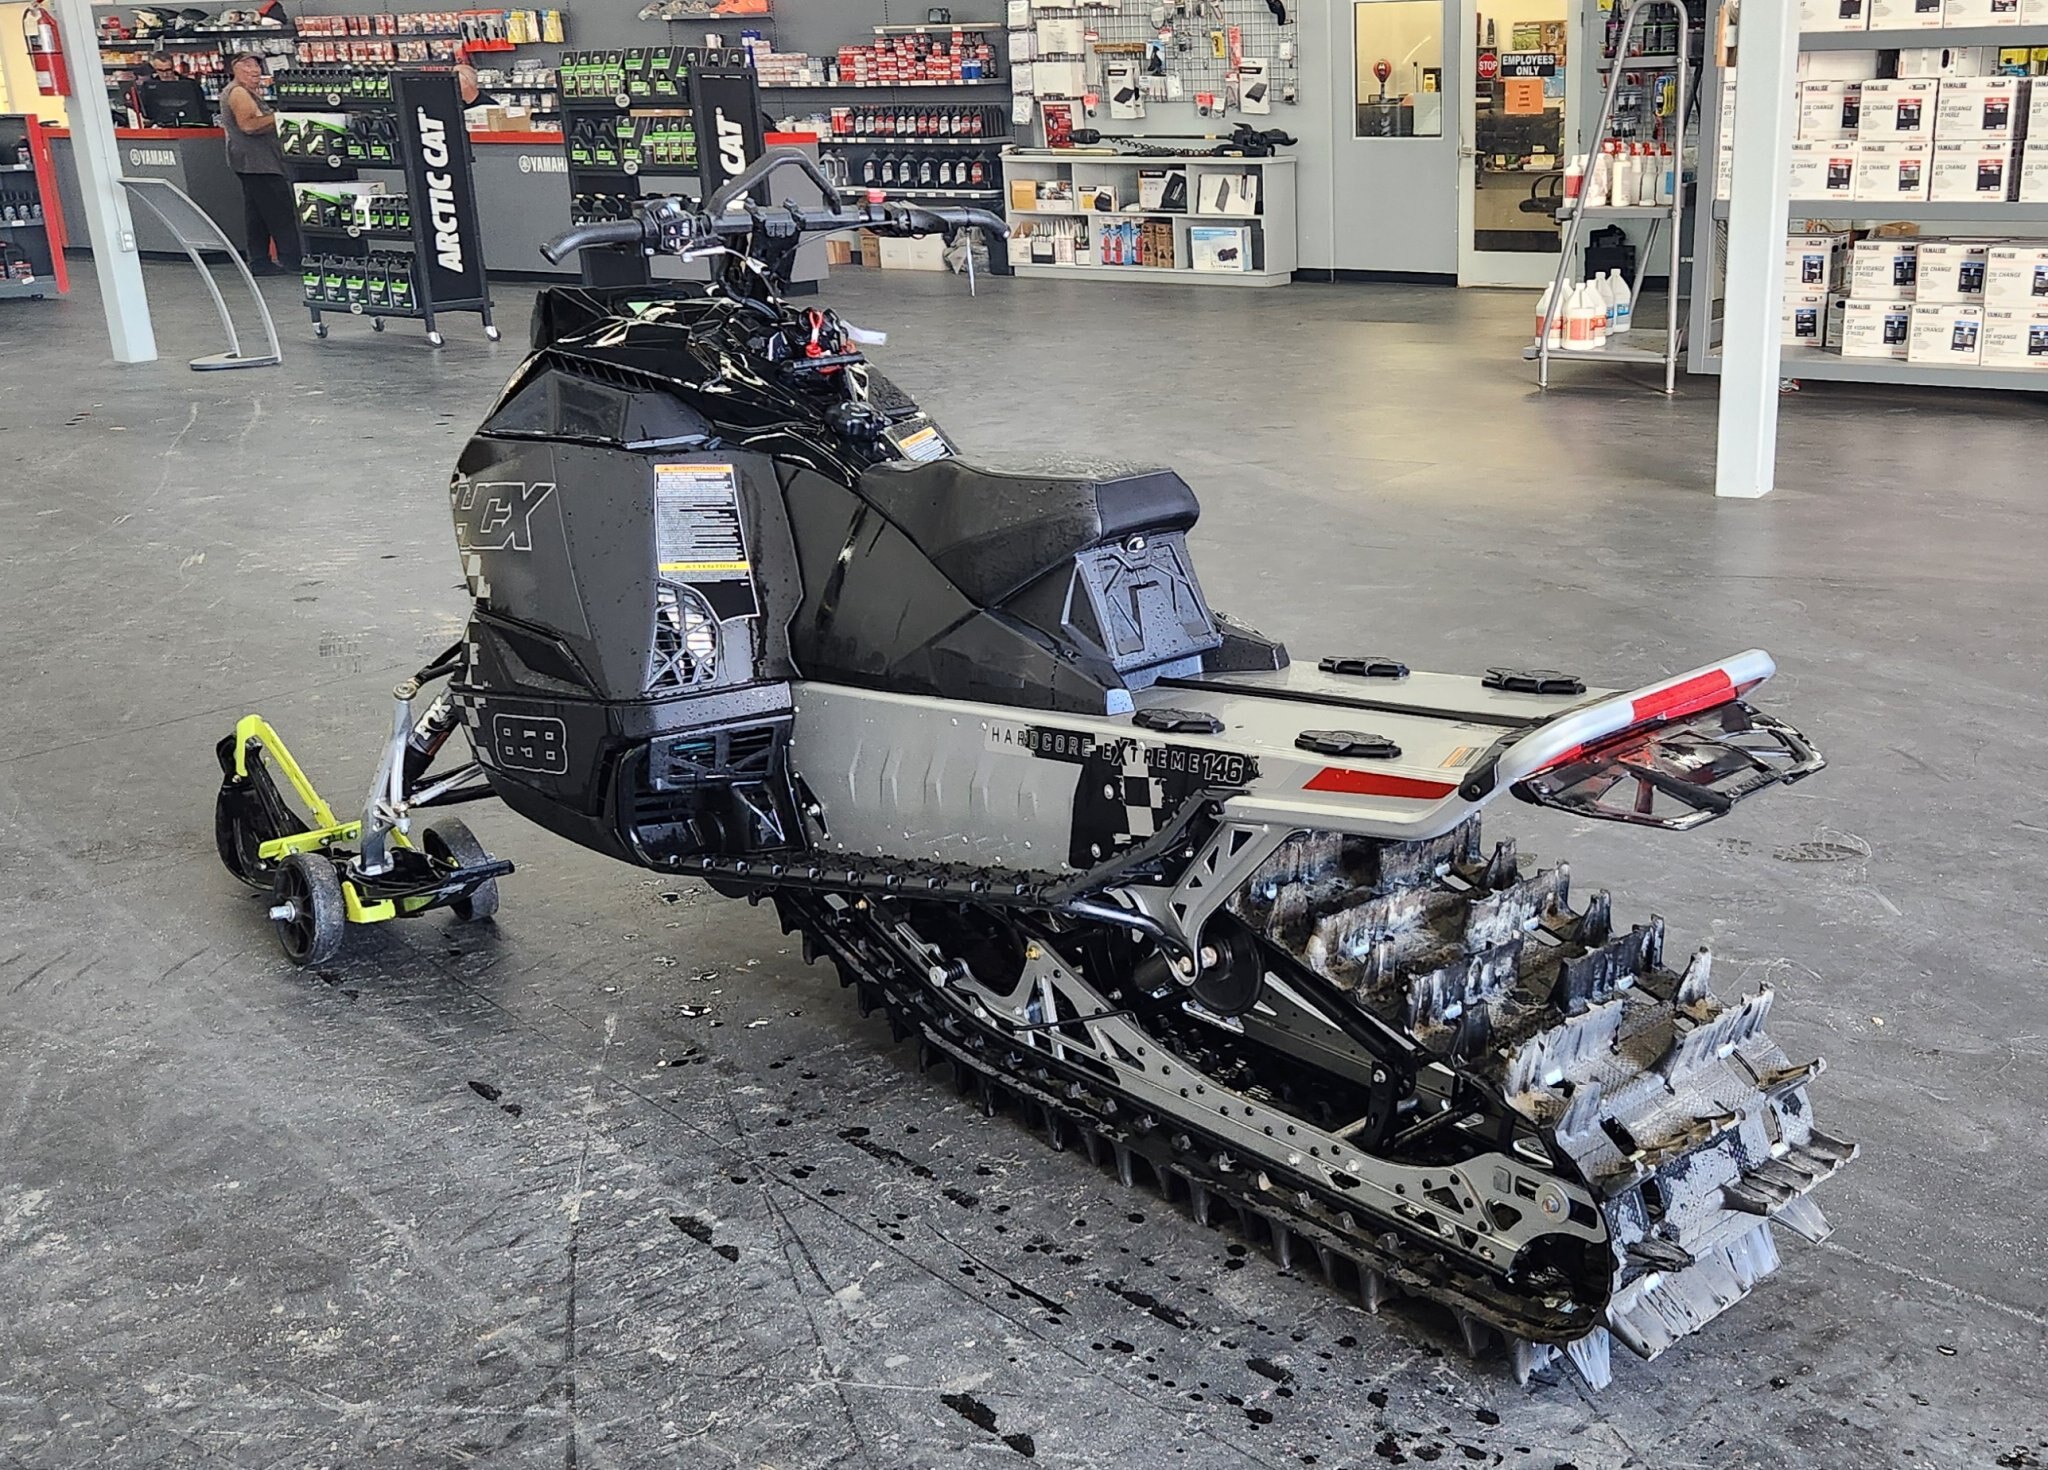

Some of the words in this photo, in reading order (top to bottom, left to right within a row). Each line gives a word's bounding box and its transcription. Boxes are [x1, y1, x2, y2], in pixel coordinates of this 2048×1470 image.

[1479, 61, 1498, 71] STOP
[1502, 55, 1554, 65] EMPLOYEES
[1516, 66, 1540, 76] ONLY
[140, 149, 176, 166] YAMAHA
[418, 112, 449, 168] CAT
[716, 114, 746, 175] CAT
[426, 171, 463, 273] ARCTIC
[414, 694, 452, 741] FOX
[493, 713, 568, 775] 858
[991, 726, 1093, 758] HARDCORE
[1102, 739, 1199, 773] EXTREME
[1202, 752, 1245, 784] 146
